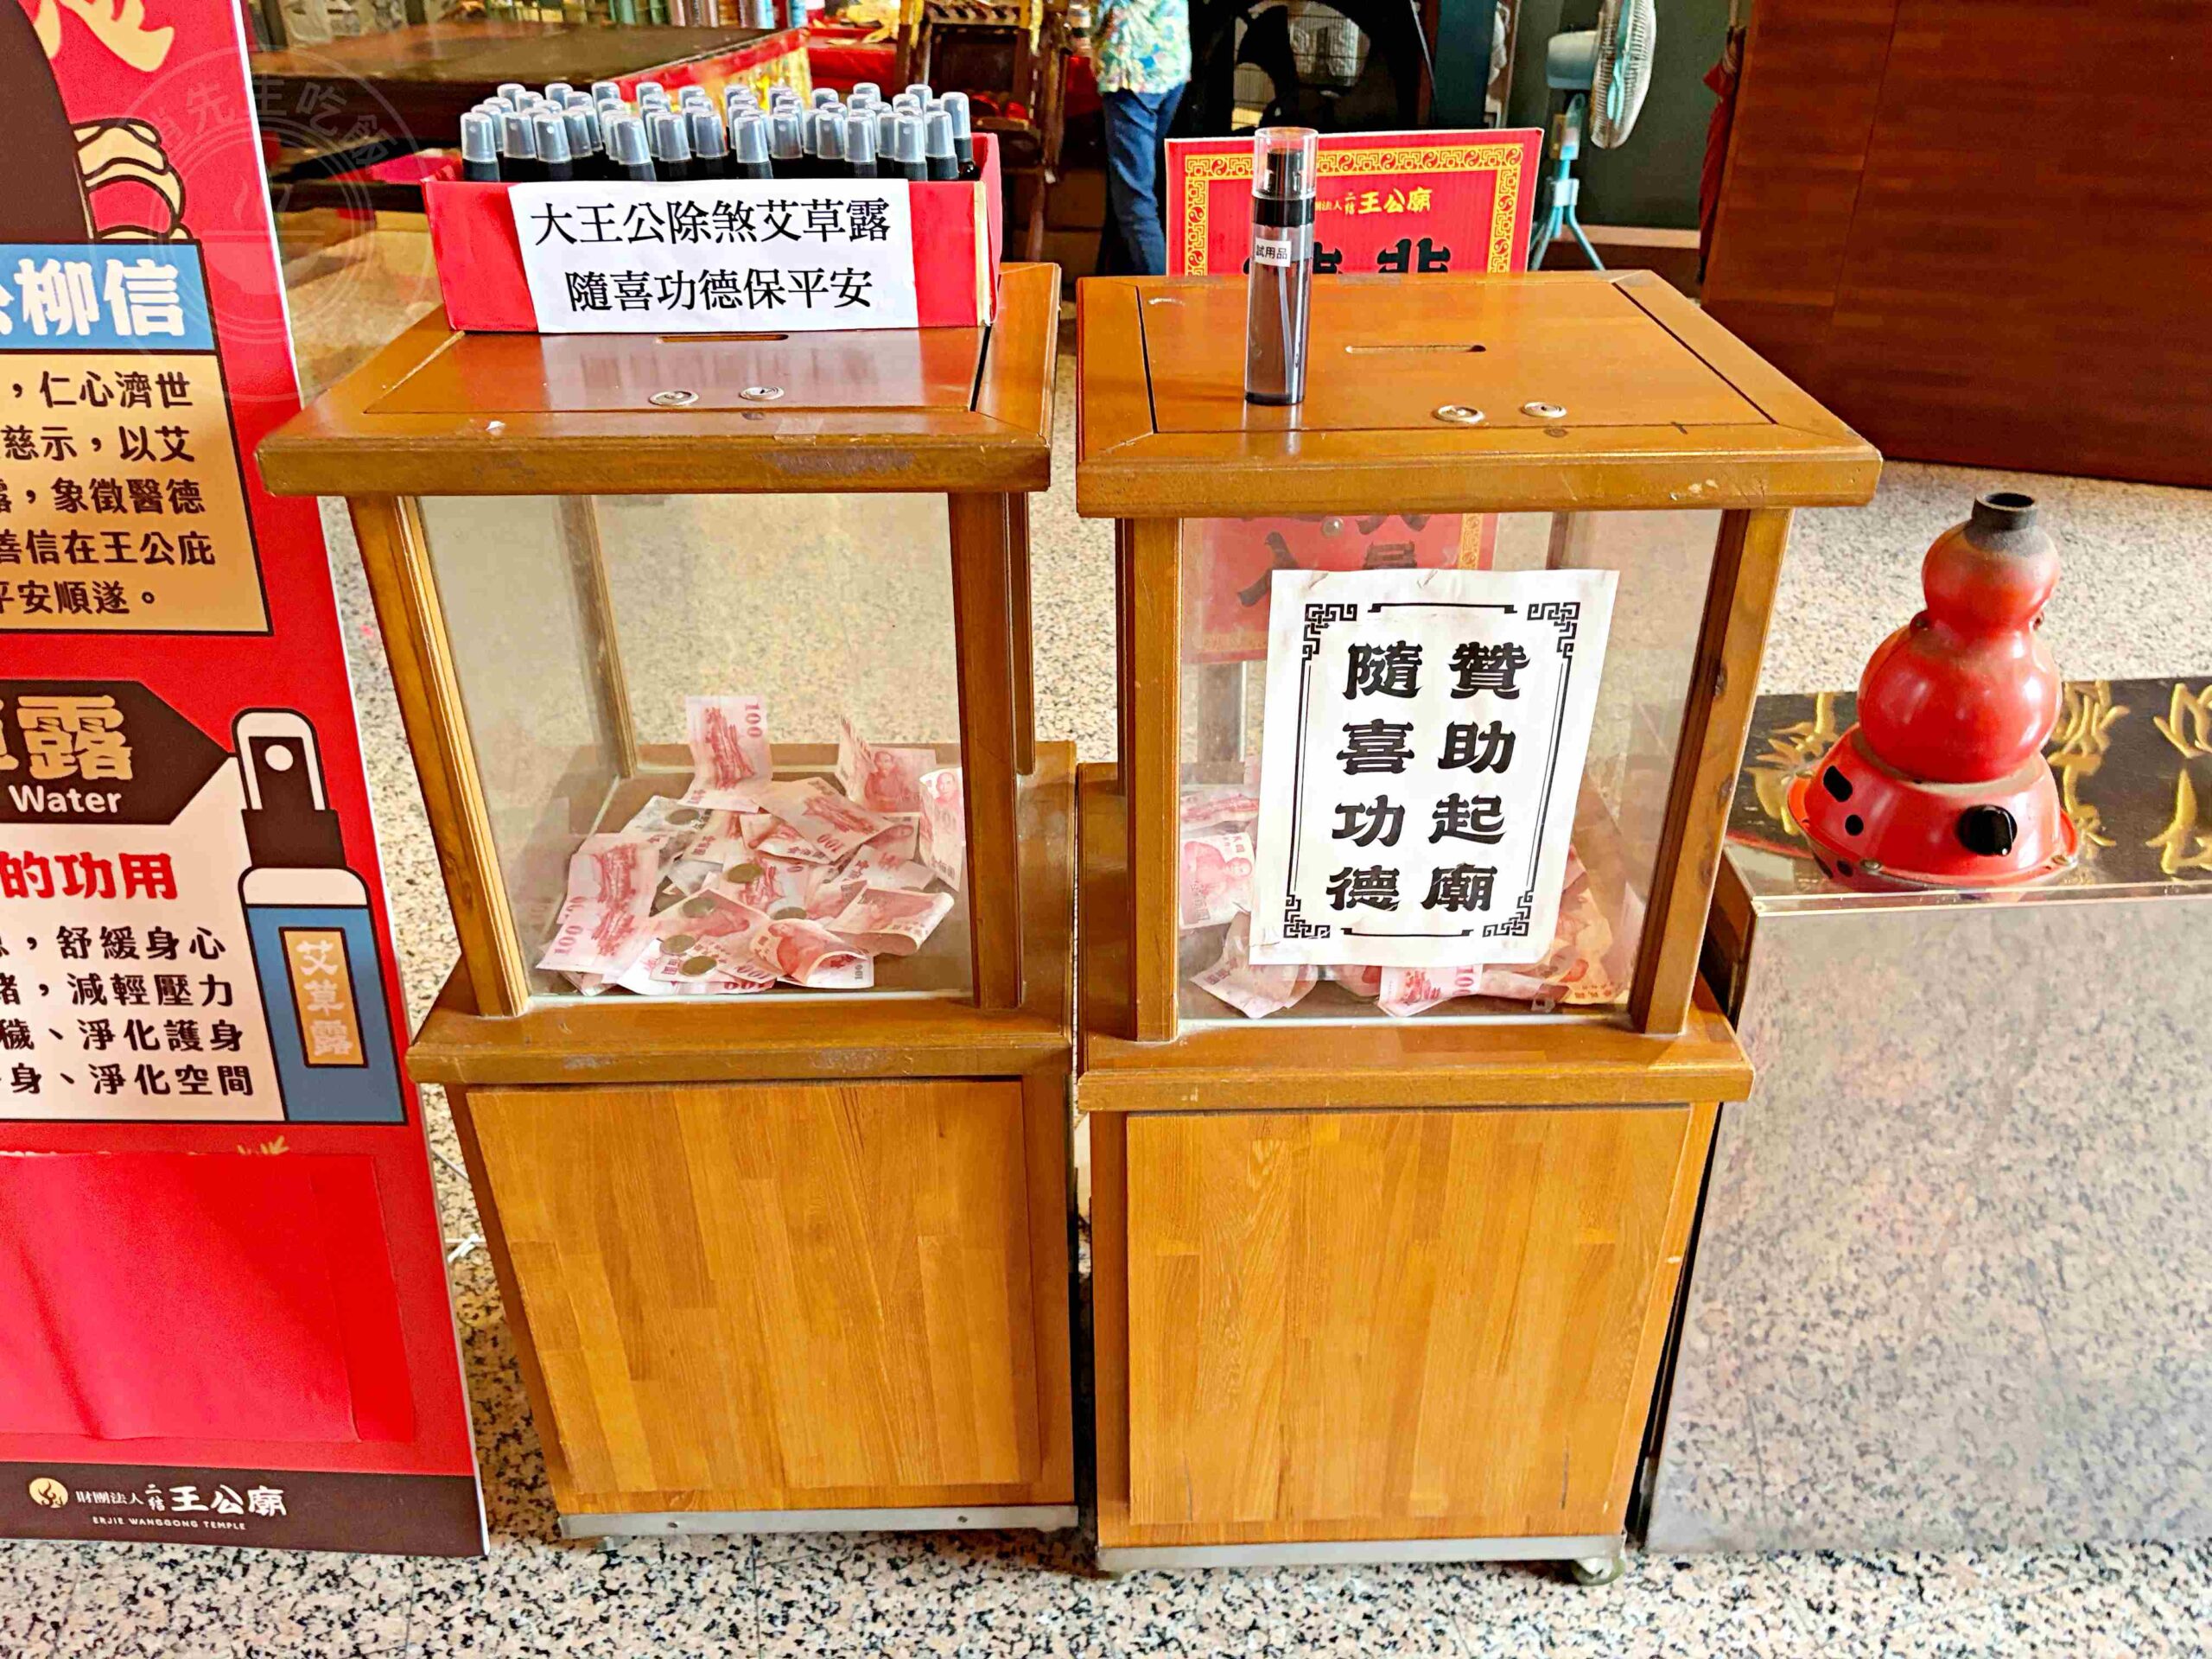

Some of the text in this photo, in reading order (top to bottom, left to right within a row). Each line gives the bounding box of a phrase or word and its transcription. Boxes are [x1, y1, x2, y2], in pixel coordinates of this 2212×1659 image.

[530, 197, 892, 245] 大王公除煞艾草露
[1255, 243, 1288, 260] 試用品
[0, 257, 186, 336] 柳信
[564, 267, 874, 313] 隨喜功德保平安
[0, 695, 134, 781] 露
[744, 703, 763, 738] 100
[1325, 639, 1425, 912] 隨喜功德
[1421, 640, 1531, 913] 贊助起廟
[8, 785, 123, 814] Water
[0, 849, 179, 900] 的功用
[0, 925, 227, 961] ，舒緩身心
[554, 925, 584, 955] 100
[295, 939, 354, 1057] 艾草露
[75, 1483, 288, 1517] 財團法人二結王公廟
[92, 1516, 247, 1531] ERJIE WANGGONG TEMPLE
